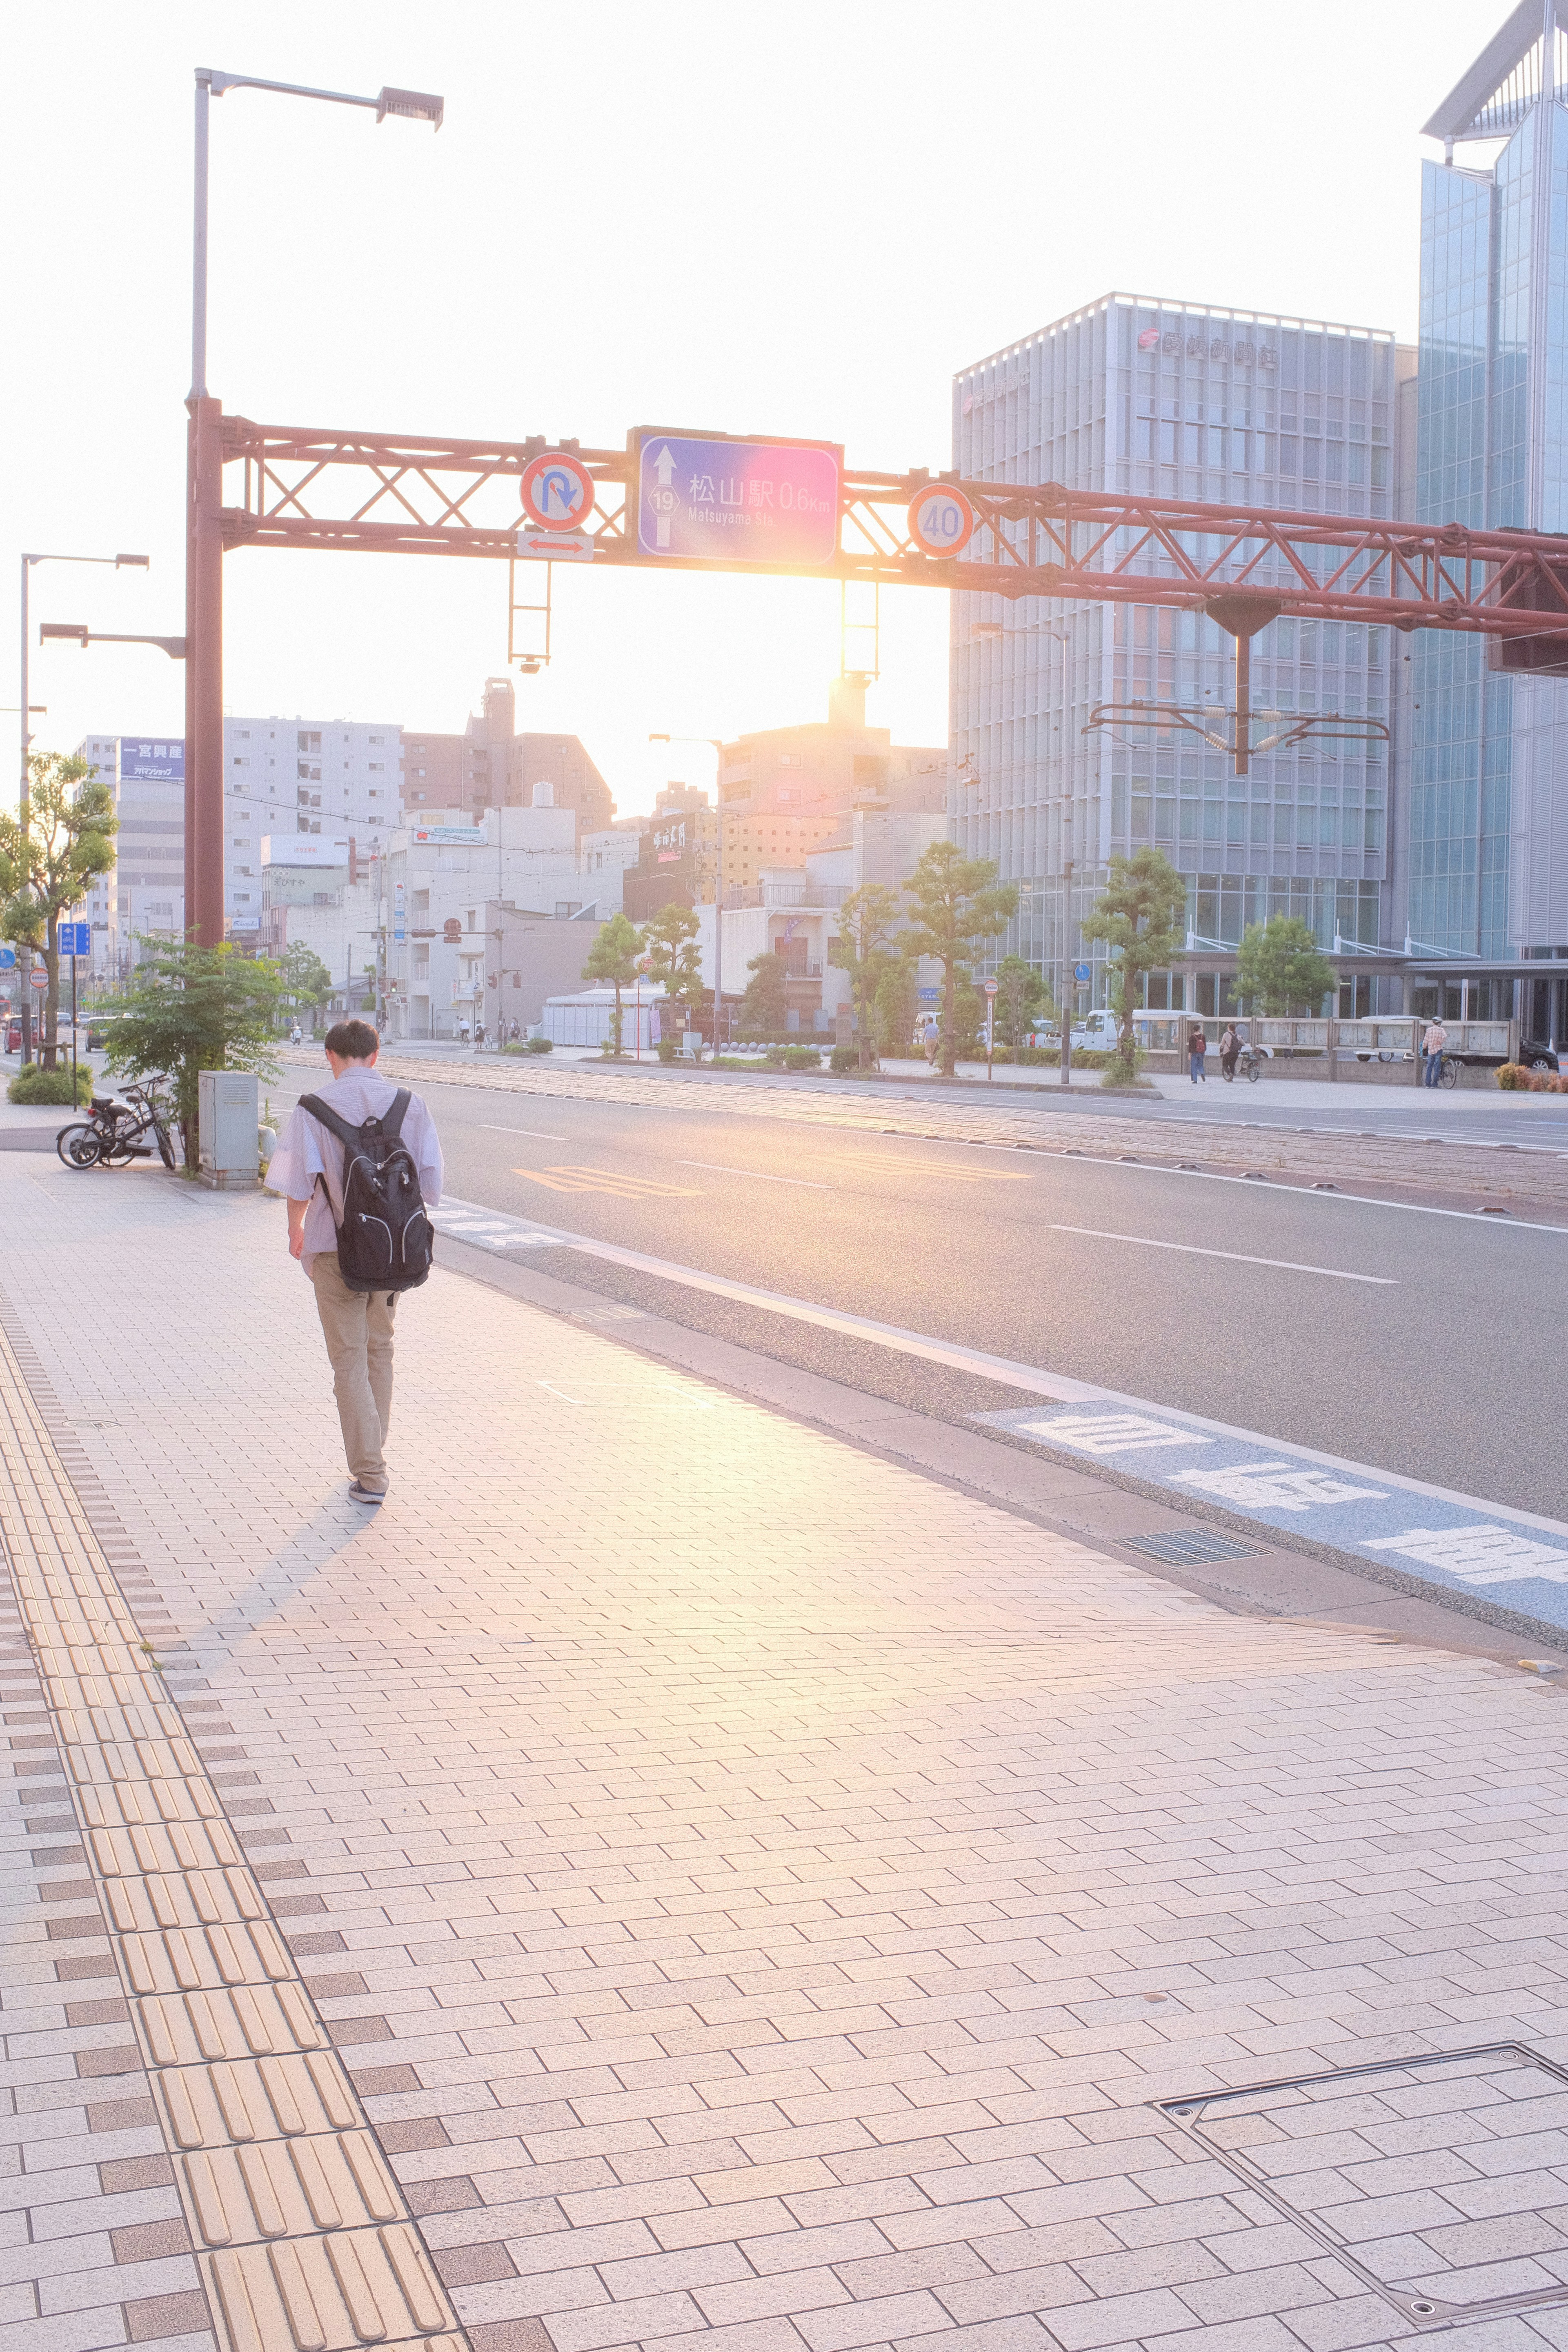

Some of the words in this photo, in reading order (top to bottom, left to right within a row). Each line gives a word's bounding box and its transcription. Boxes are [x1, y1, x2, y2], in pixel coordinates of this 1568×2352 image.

[1165, 332, 1277, 364] 愛媛新聞社
[654, 491, 674, 511] 19
[689, 474, 774, 509] 松山駅
[688, 506, 752, 526] Matsuyama
[755, 510, 776, 528] Sta.
[923, 504, 959, 538] 40
[124, 744, 182, 758] 一宮興産
[274, 876, 305, 887] えびすや
